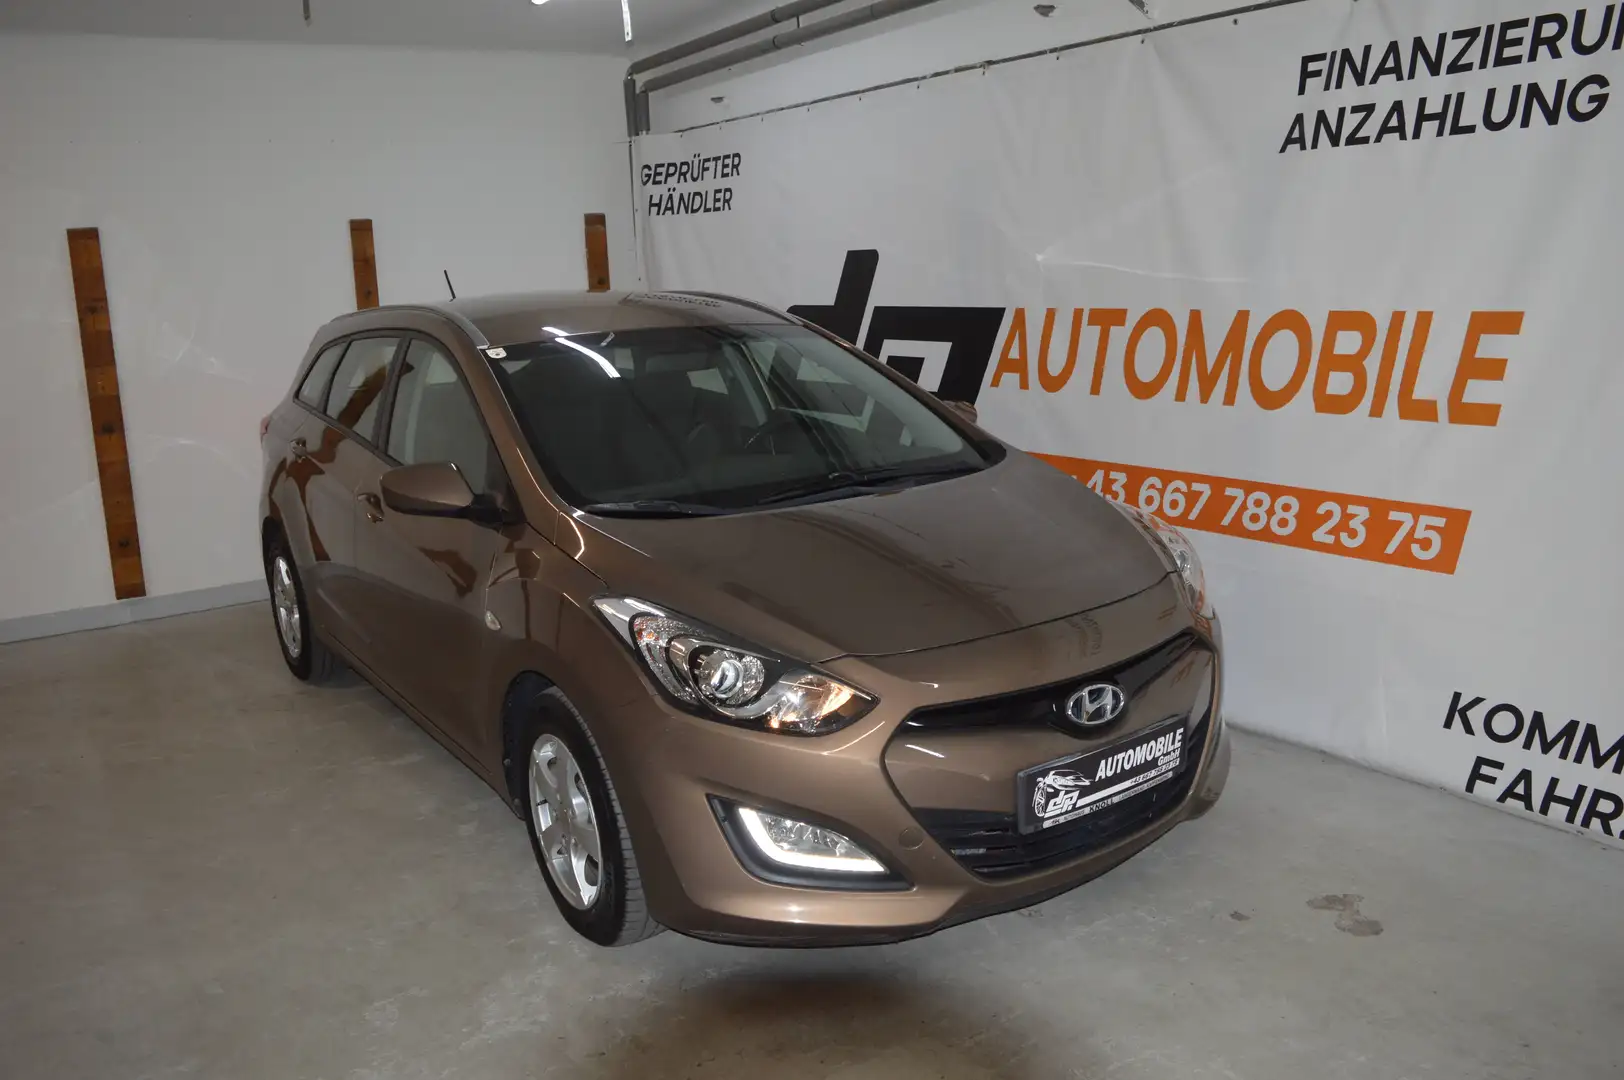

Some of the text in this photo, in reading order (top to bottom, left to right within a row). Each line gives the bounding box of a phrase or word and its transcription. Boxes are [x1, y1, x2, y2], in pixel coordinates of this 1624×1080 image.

[1279, 74, 1610, 153] ANZAHLUNG
[641, 153, 741, 186] GEPRÜFTER
[648, 187, 733, 216] HÄNDLER
[990, 307, 1525, 427] AUTOMOBILE
[1138, 476, 1211, 520] 667
[1220, 487, 1299, 536] 788
[1311, 501, 1370, 548] 23
[1383, 511, 1447, 560] 75
[1095, 728, 1184, 782] AUTOMOBILE
[1157, 748, 1181, 766] GmbH
[1089, 798, 1114, 813] KNOLL
[1465, 756, 1624, 841] FAHR
